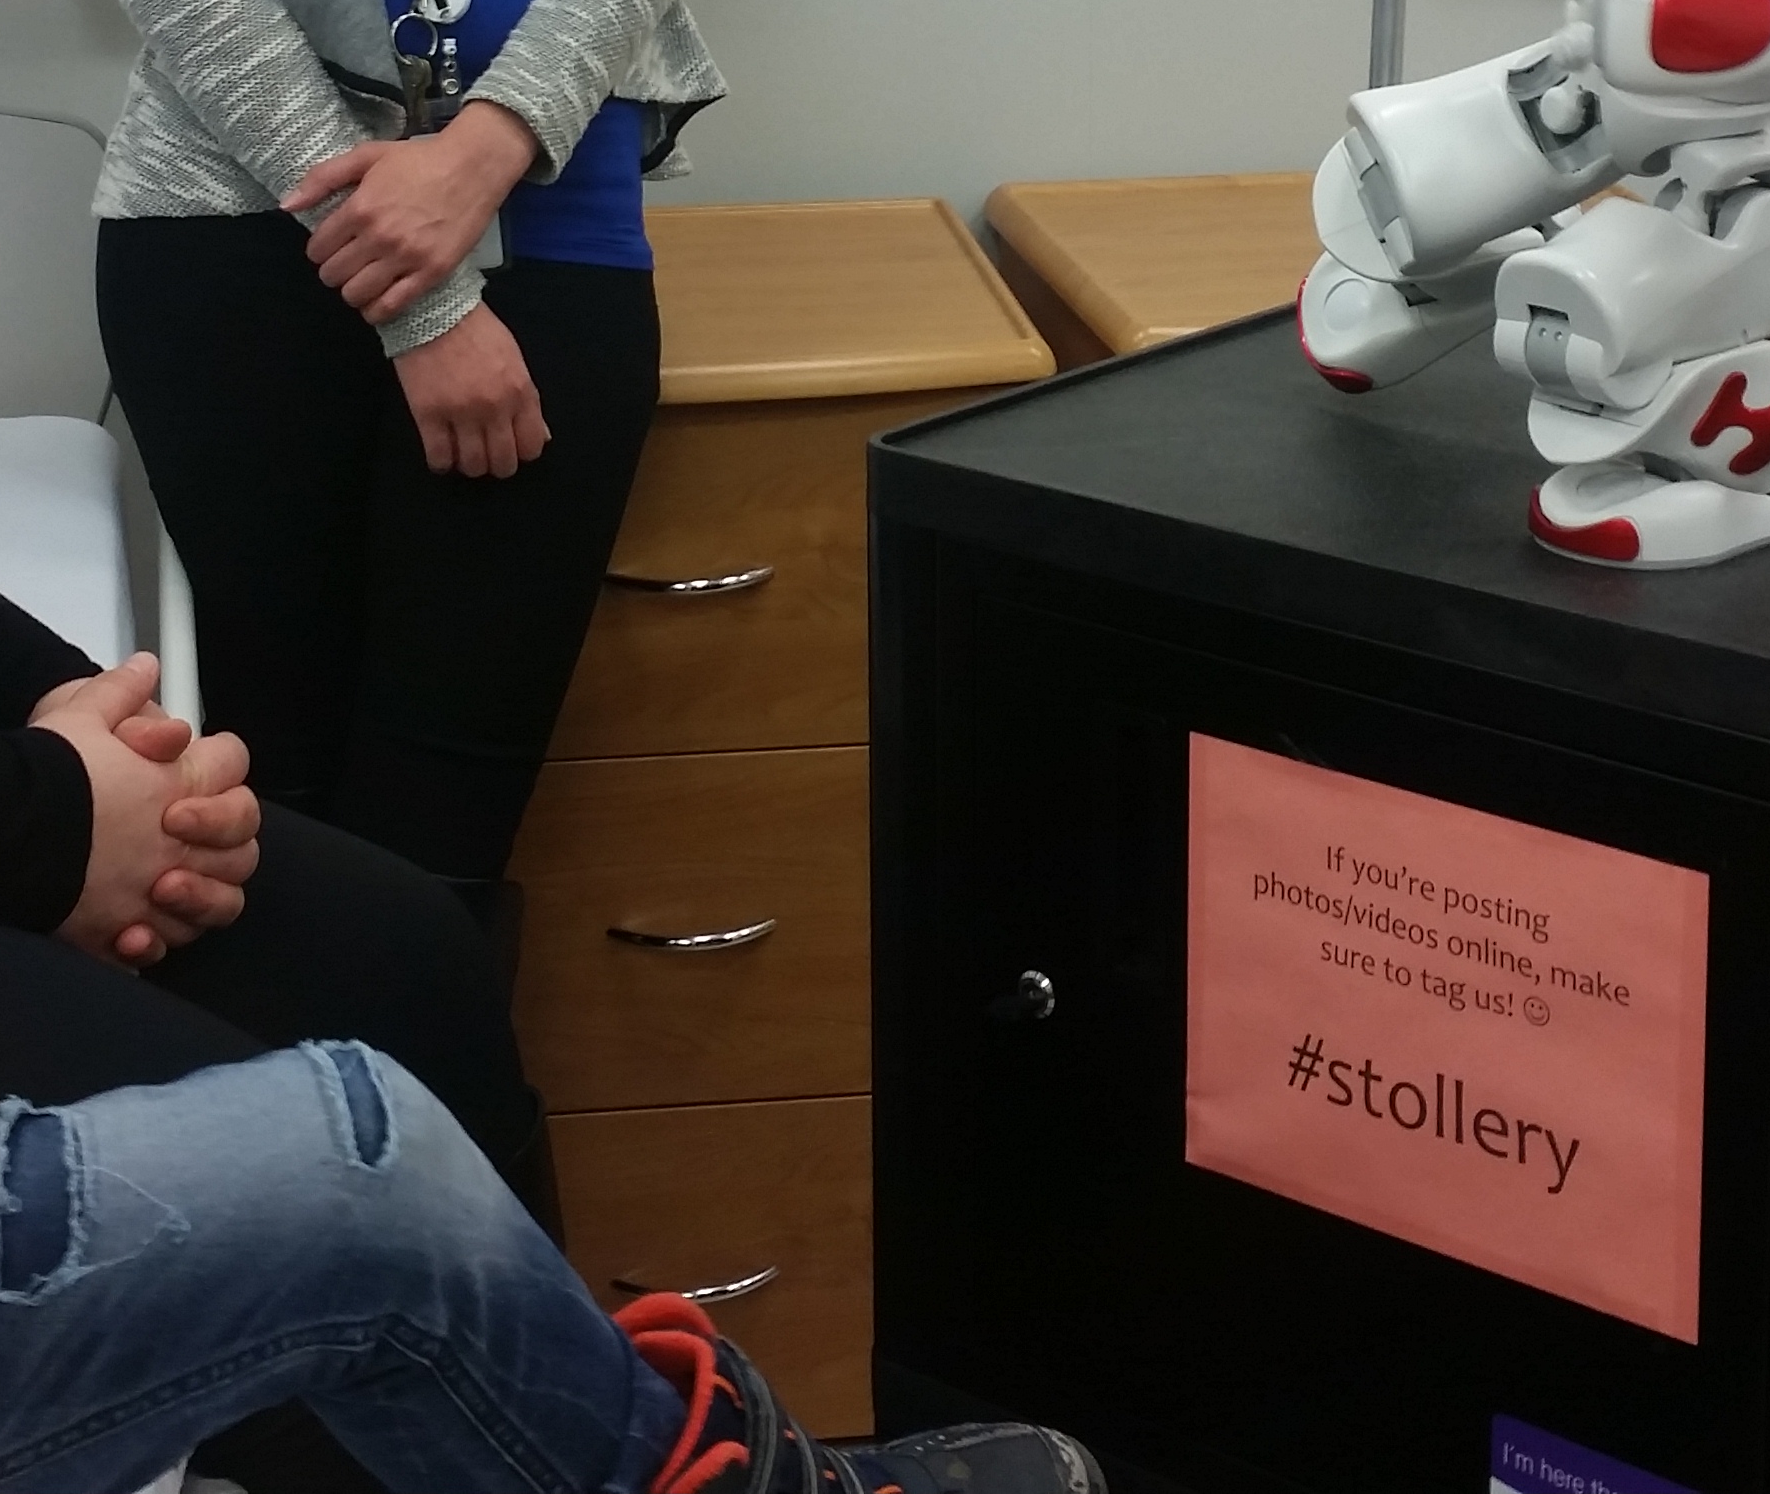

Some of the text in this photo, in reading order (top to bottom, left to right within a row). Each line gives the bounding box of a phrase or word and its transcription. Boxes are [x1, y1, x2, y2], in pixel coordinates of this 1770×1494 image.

[1253, 868, 1630, 1007] photos/videos online, make
[1325, 844, 1551, 943] If you’re posting
[1320, 943, 1514, 1018] sure to tag us!
[1287, 1032, 1581, 1195] #stollery
[1502, 1441, 1535, 1475] I'm
[1539, 1457, 1585, 1494] here
